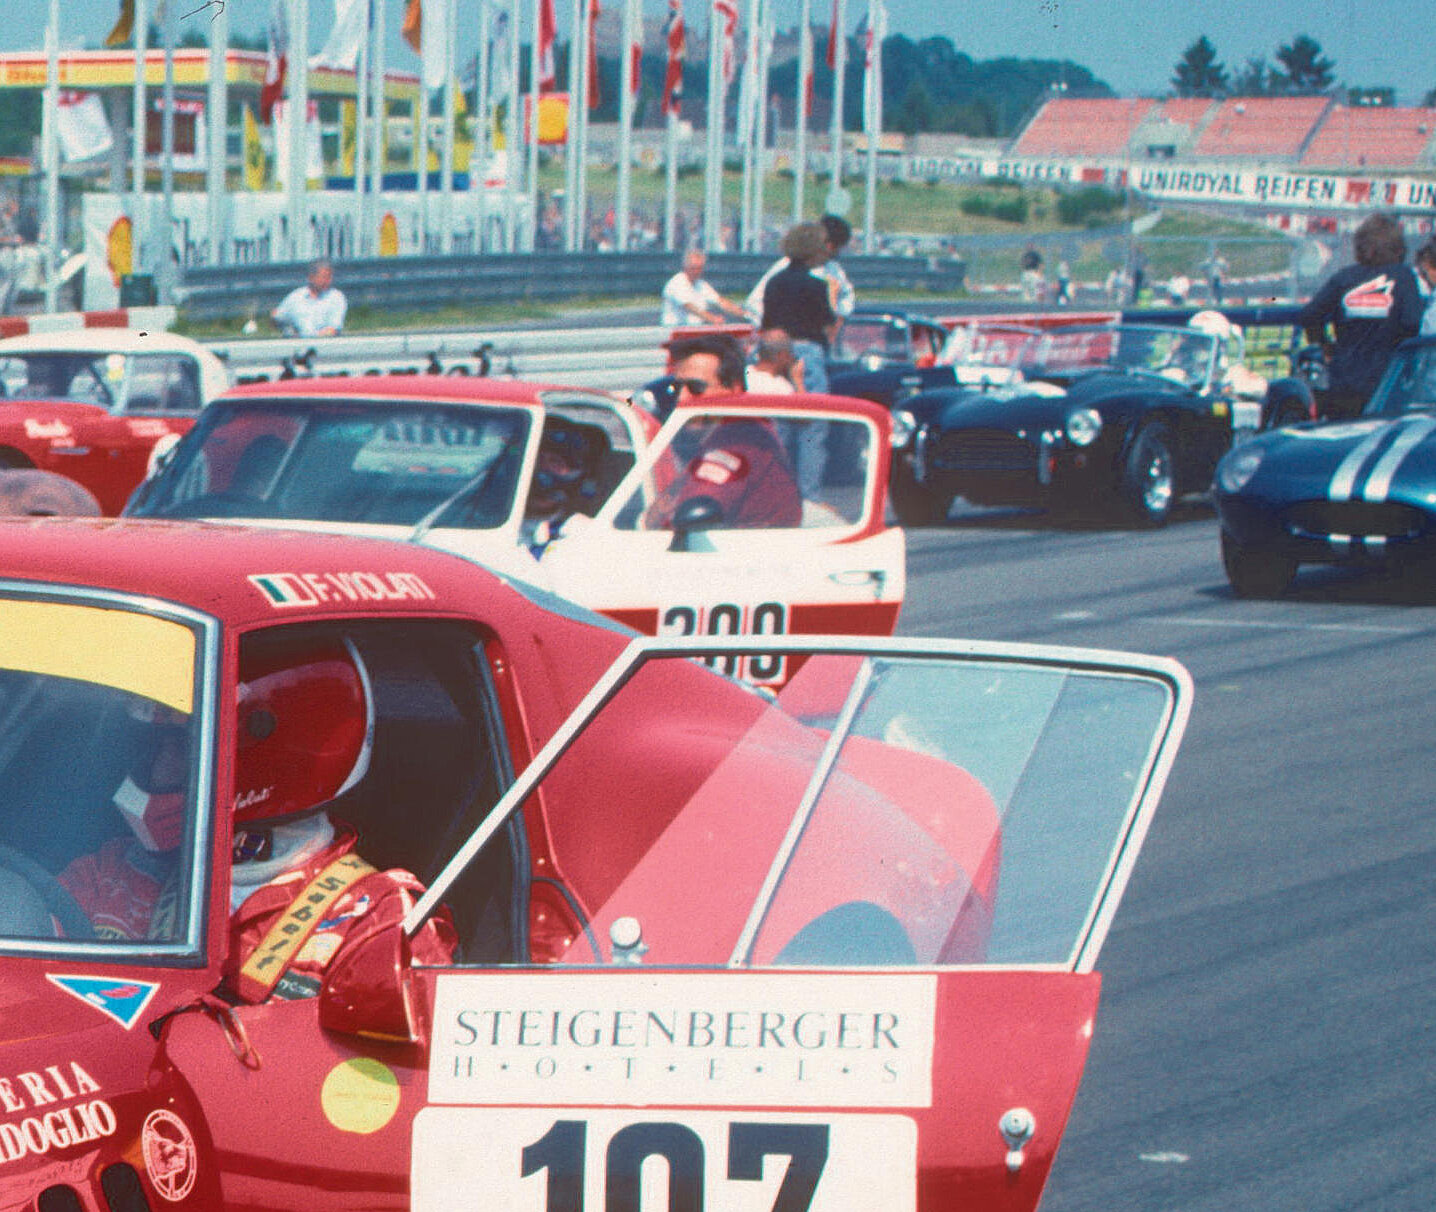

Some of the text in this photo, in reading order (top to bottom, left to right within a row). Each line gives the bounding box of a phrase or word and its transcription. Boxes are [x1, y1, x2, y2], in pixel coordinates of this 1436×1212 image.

[1139, 170, 1336, 200] UNIROYAL REIFEN
[454, 1009, 901, 1050] STEIGENBERGER
